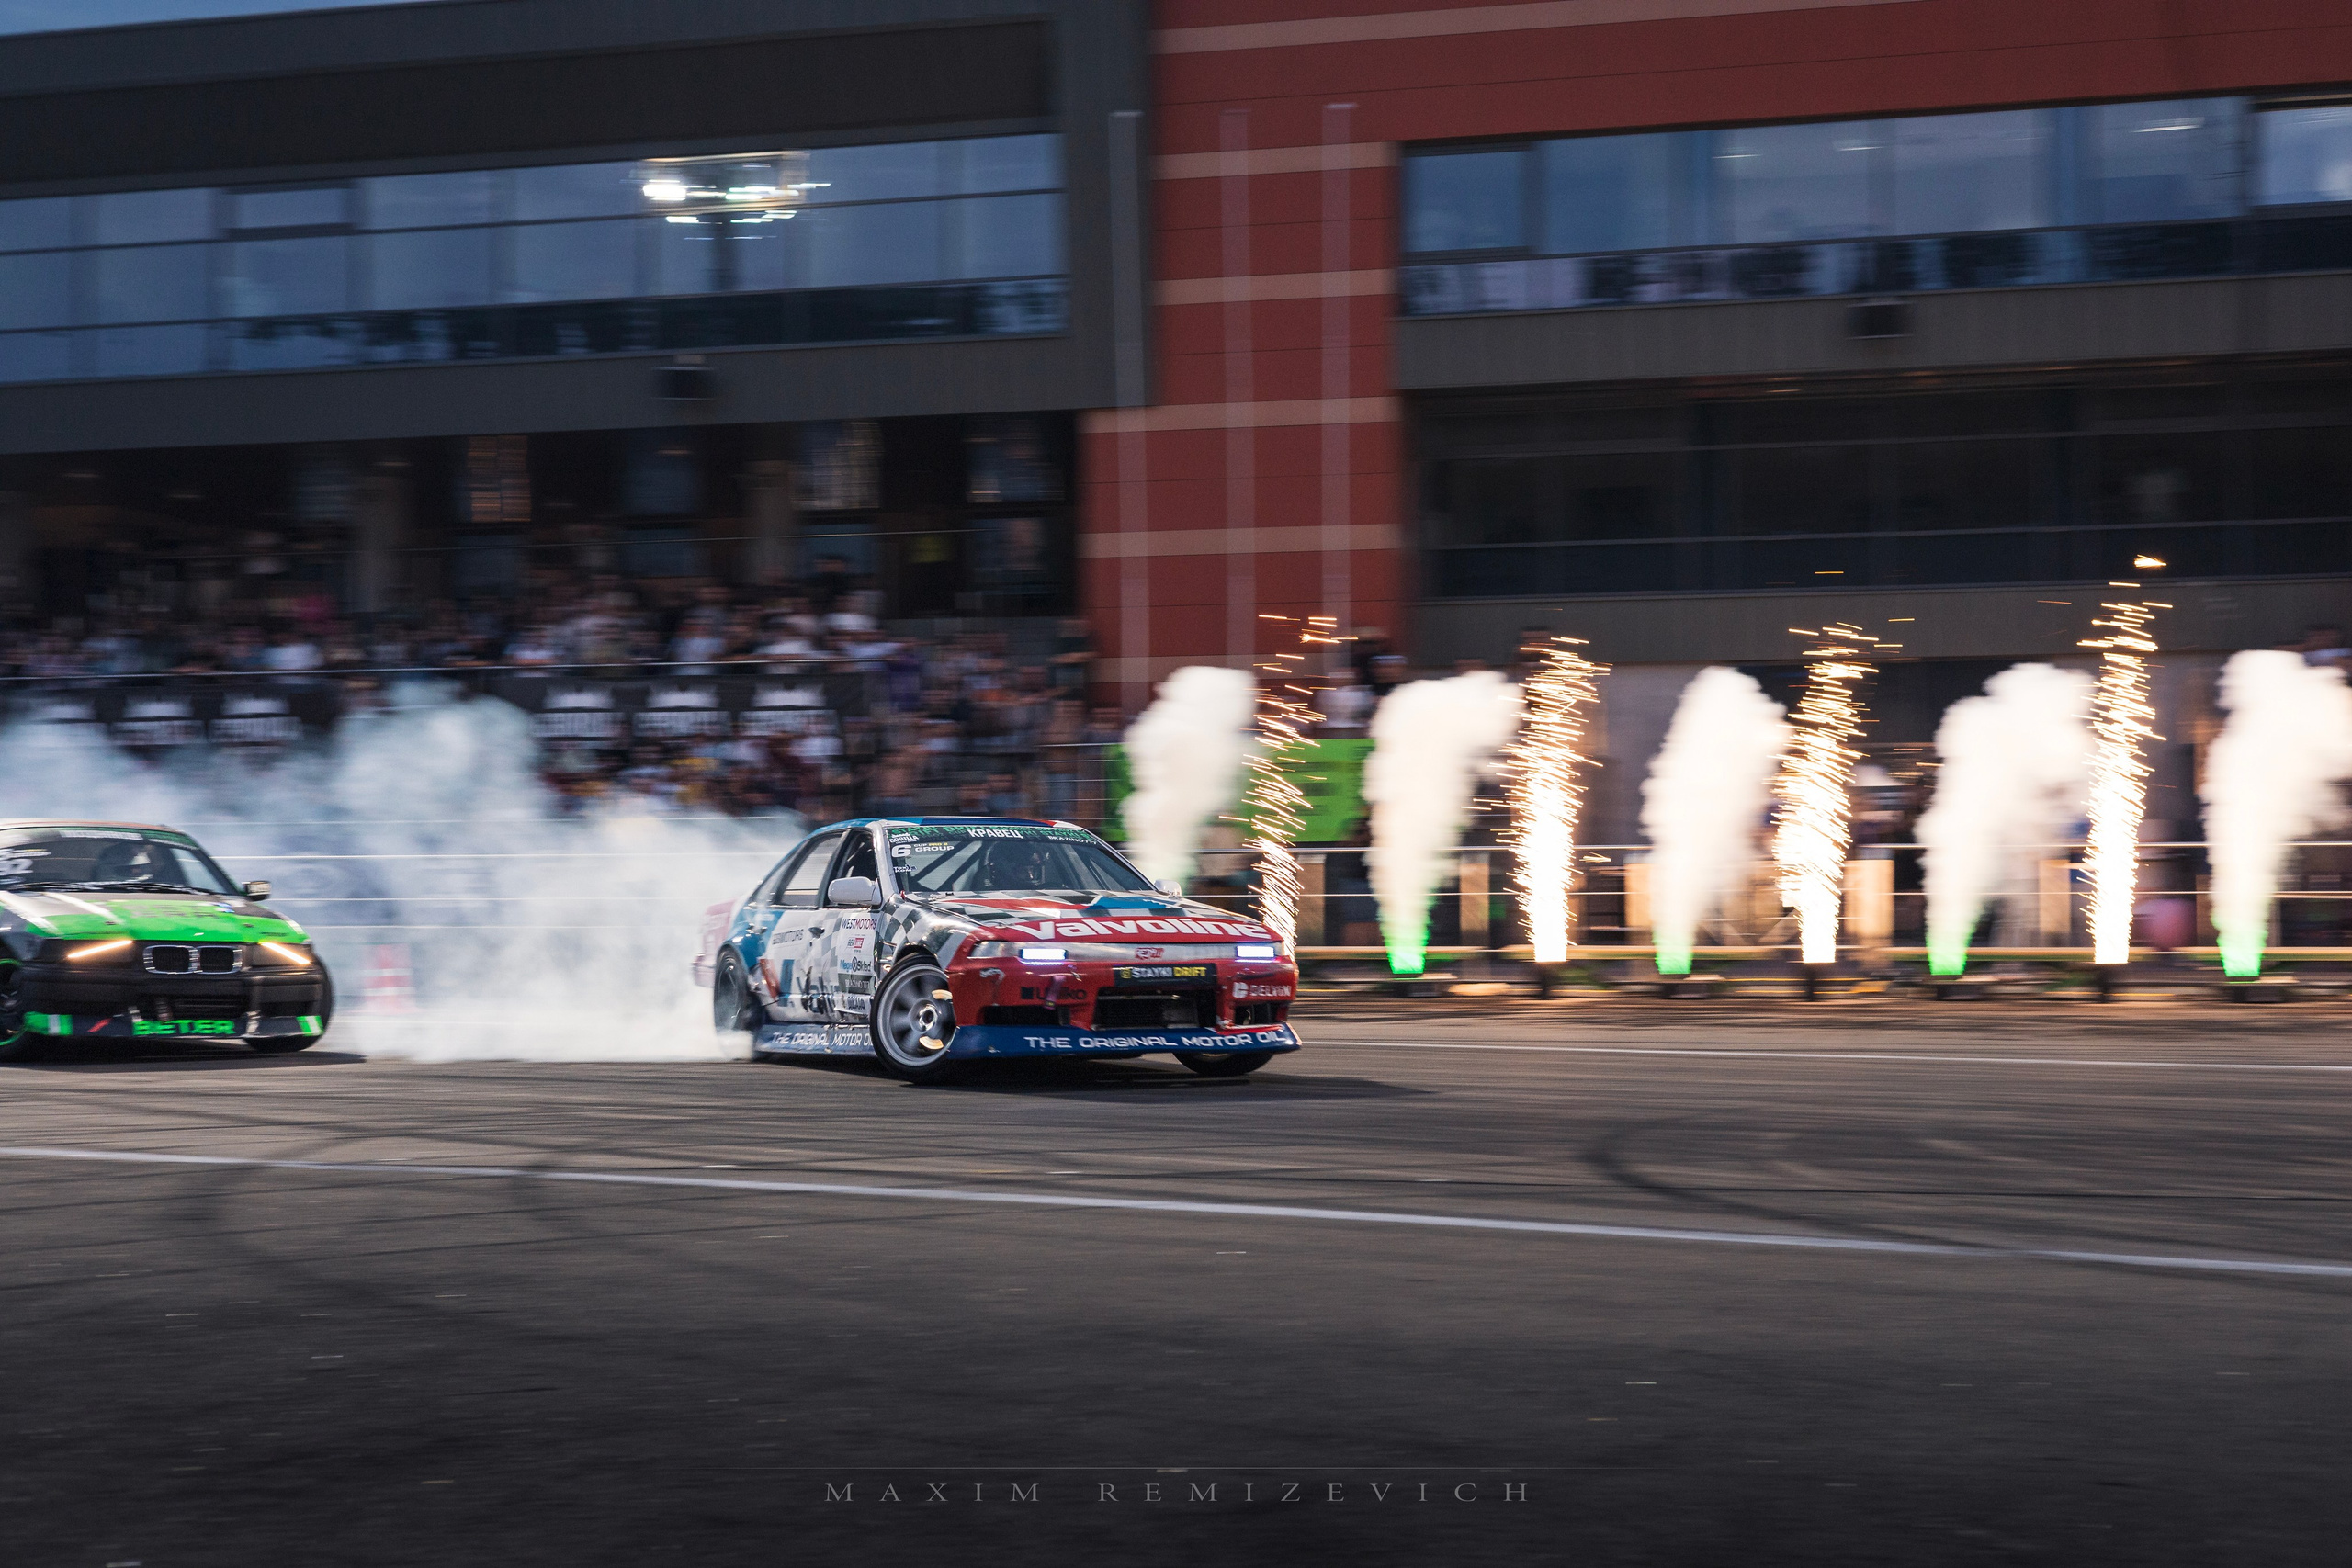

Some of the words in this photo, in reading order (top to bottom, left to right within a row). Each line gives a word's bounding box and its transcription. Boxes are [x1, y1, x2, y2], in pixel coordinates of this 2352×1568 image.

[888, 835, 920, 843] GORILLA
[967, 829, 1024, 840] КРАВЕЦ
[891, 844, 912, 858] 6
[842, 918, 877, 931] WESTMOTORS
[1012, 917, 1272, 942] Valvoline
[1132, 966, 1172, 978] STAYKI
[1173, 966, 1207, 977] DRIFT
[772, 1032, 792, 1044] THE
[792, 1032, 830, 1046] ORIGINAL
[831, 1032, 863, 1046] MOTOR
[1023, 1036, 1071, 1049] THE
[1079, 1036, 1178, 1049] ORIGINAL
[1182, 1033, 1254, 1048] MOTOR
[1256, 1031, 1287, 1043] OIL
